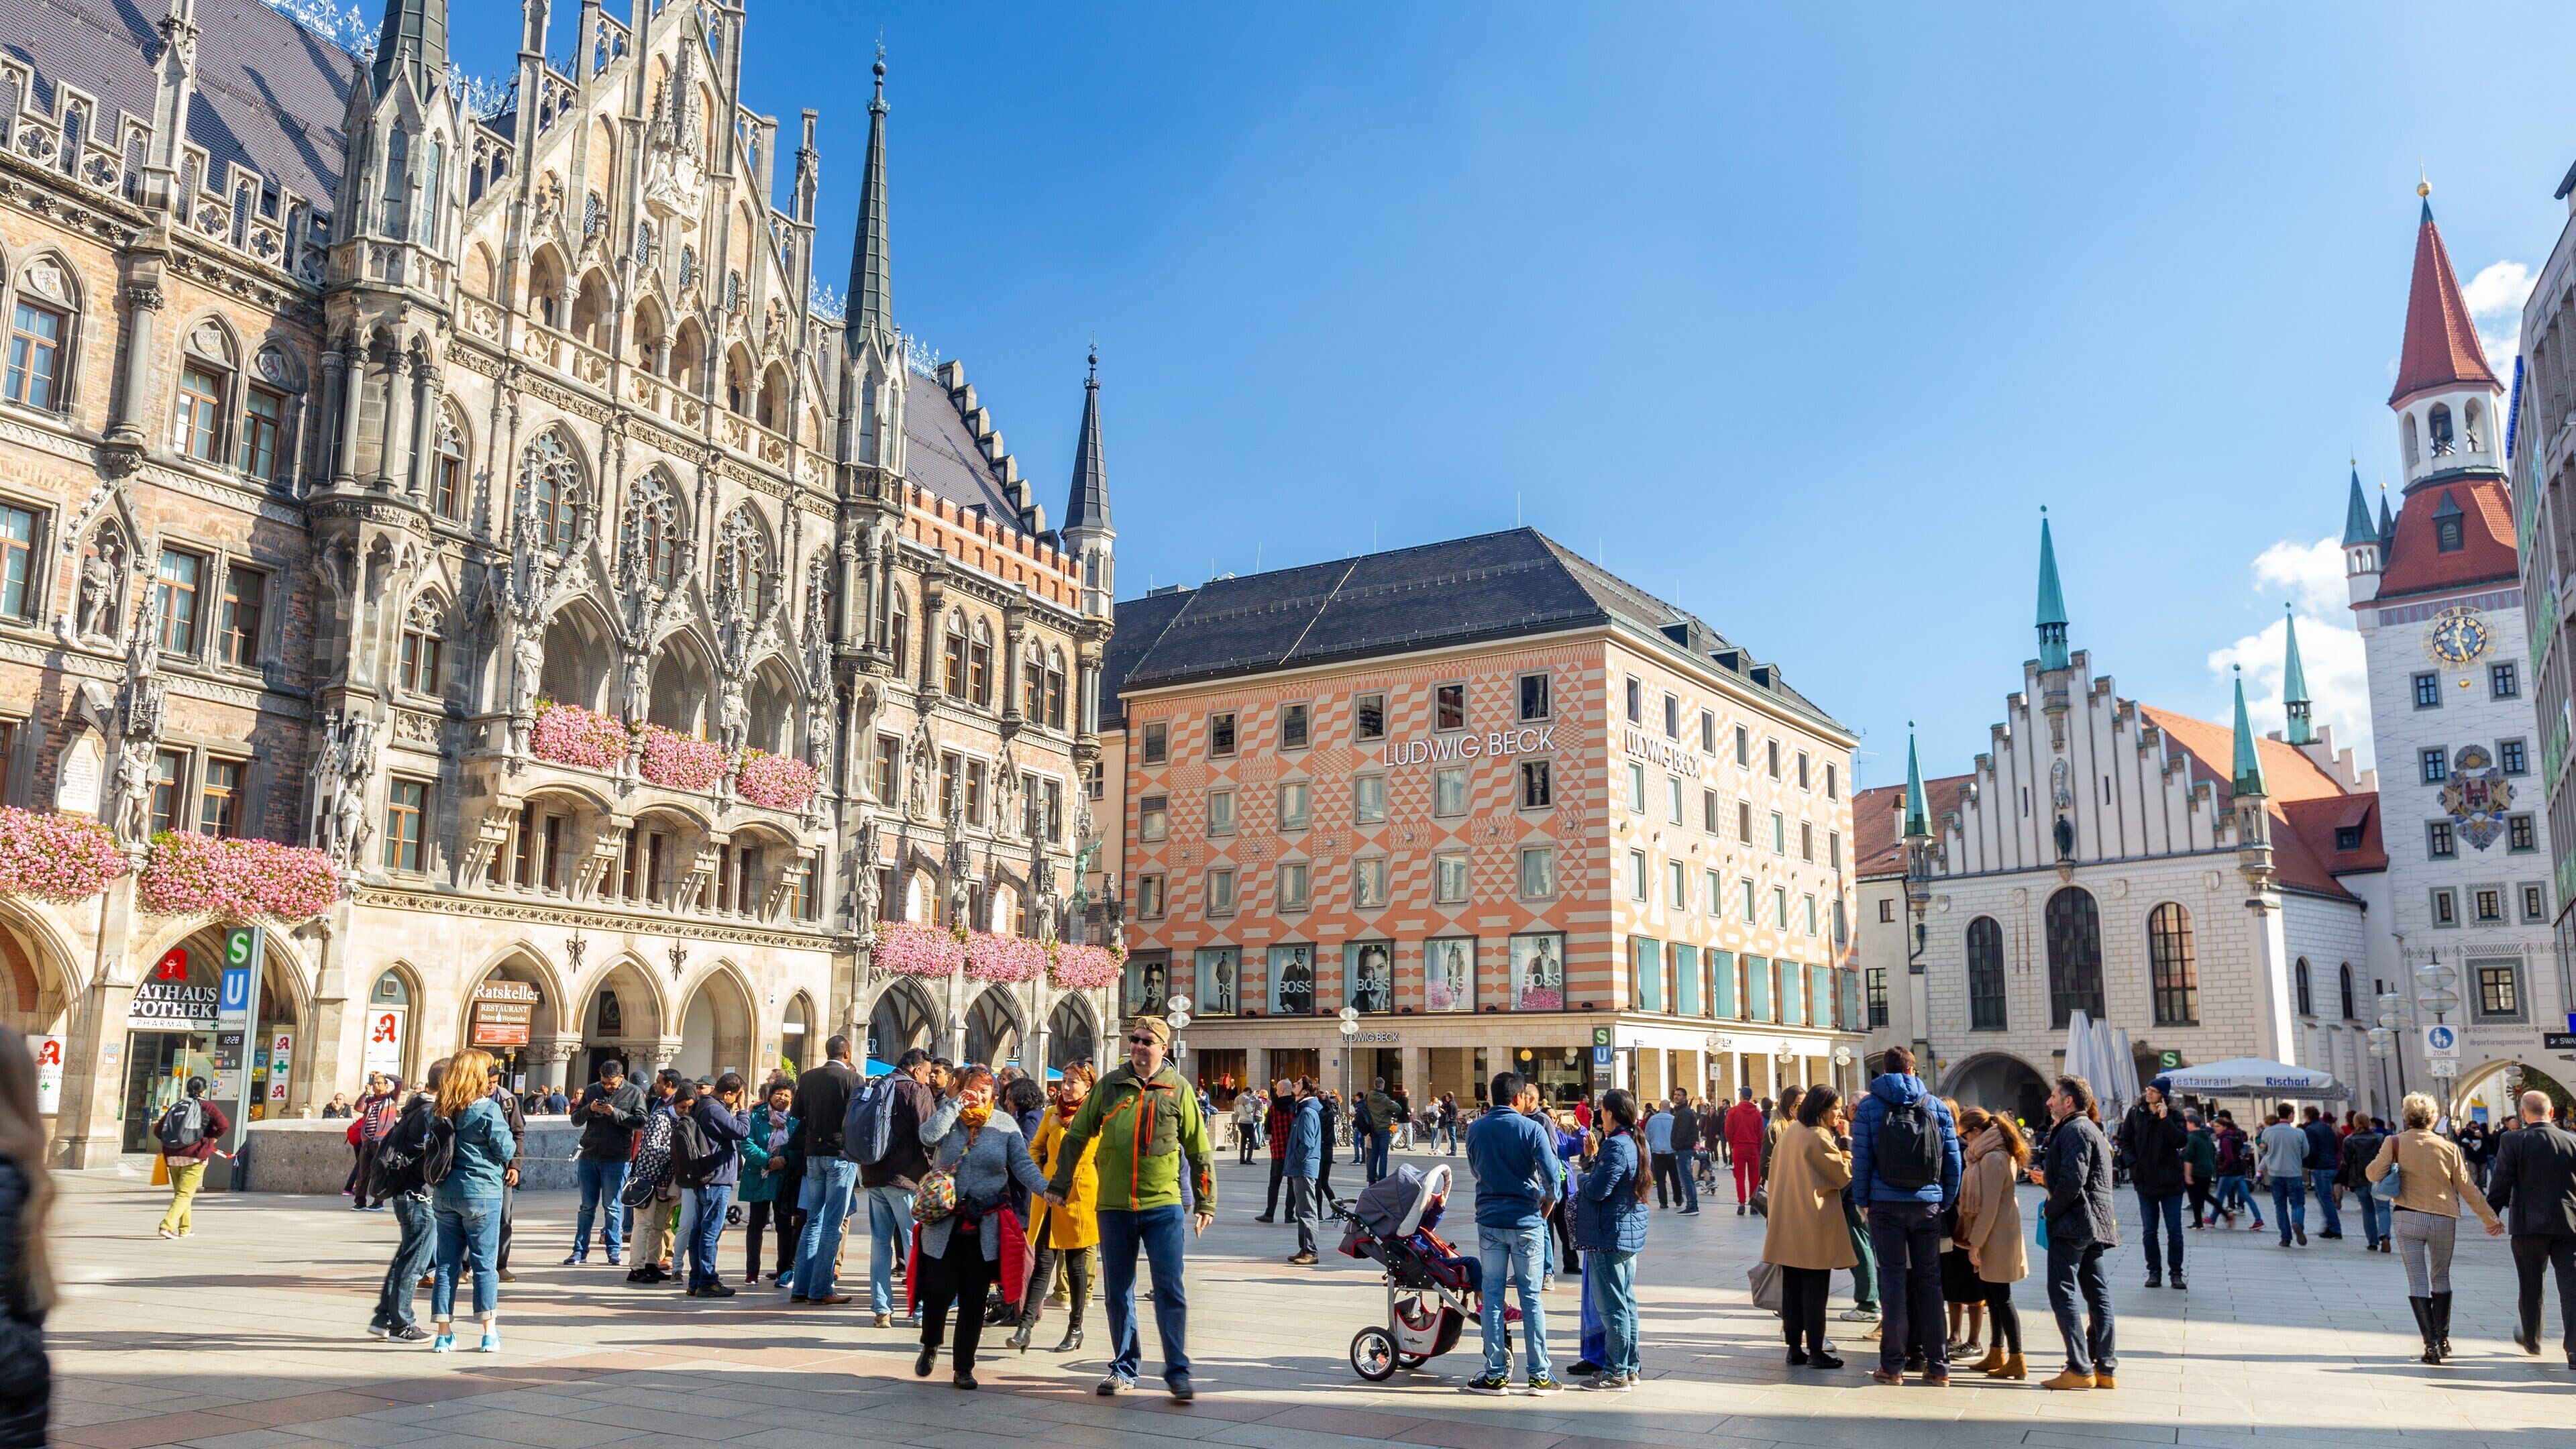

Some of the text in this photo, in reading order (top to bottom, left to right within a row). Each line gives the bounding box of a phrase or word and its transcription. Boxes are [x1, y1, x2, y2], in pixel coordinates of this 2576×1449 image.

[1384, 727, 1556, 767] LUDWIG BECK
[1625, 729, 1701, 780] LUDWIG BECK
[231, 932, 248, 964] S
[1279, 980, 1311, 994] BOSS
[1356, 978, 1390, 991] BOSS
[1523, 973, 1562, 987] BOSS
[134, 983, 217, 1002] ATHAUS
[227, 974, 244, 1005] U
[472, 983, 540, 1001] Ratskeller
[129, 1000, 219, 1018] POTHEK
[480, 1004, 529, 1013] RESTAURANT
[137, 1019, 198, 1028] PHARMACIE
[502, 1014, 527, 1022] Weinstube
[224, 1036, 239, 1044] 12:28
[1377, 1032, 1399, 1042] BECK
[1597, 1030, 1608, 1044] S
[2469, 1038, 2535, 1046] Spielzeugmuseum
[1597, 1049, 1607, 1062] U
[2163, 1052, 2177, 1067] S
[2169, 1077, 2310, 1087] Restaurant Rischart
